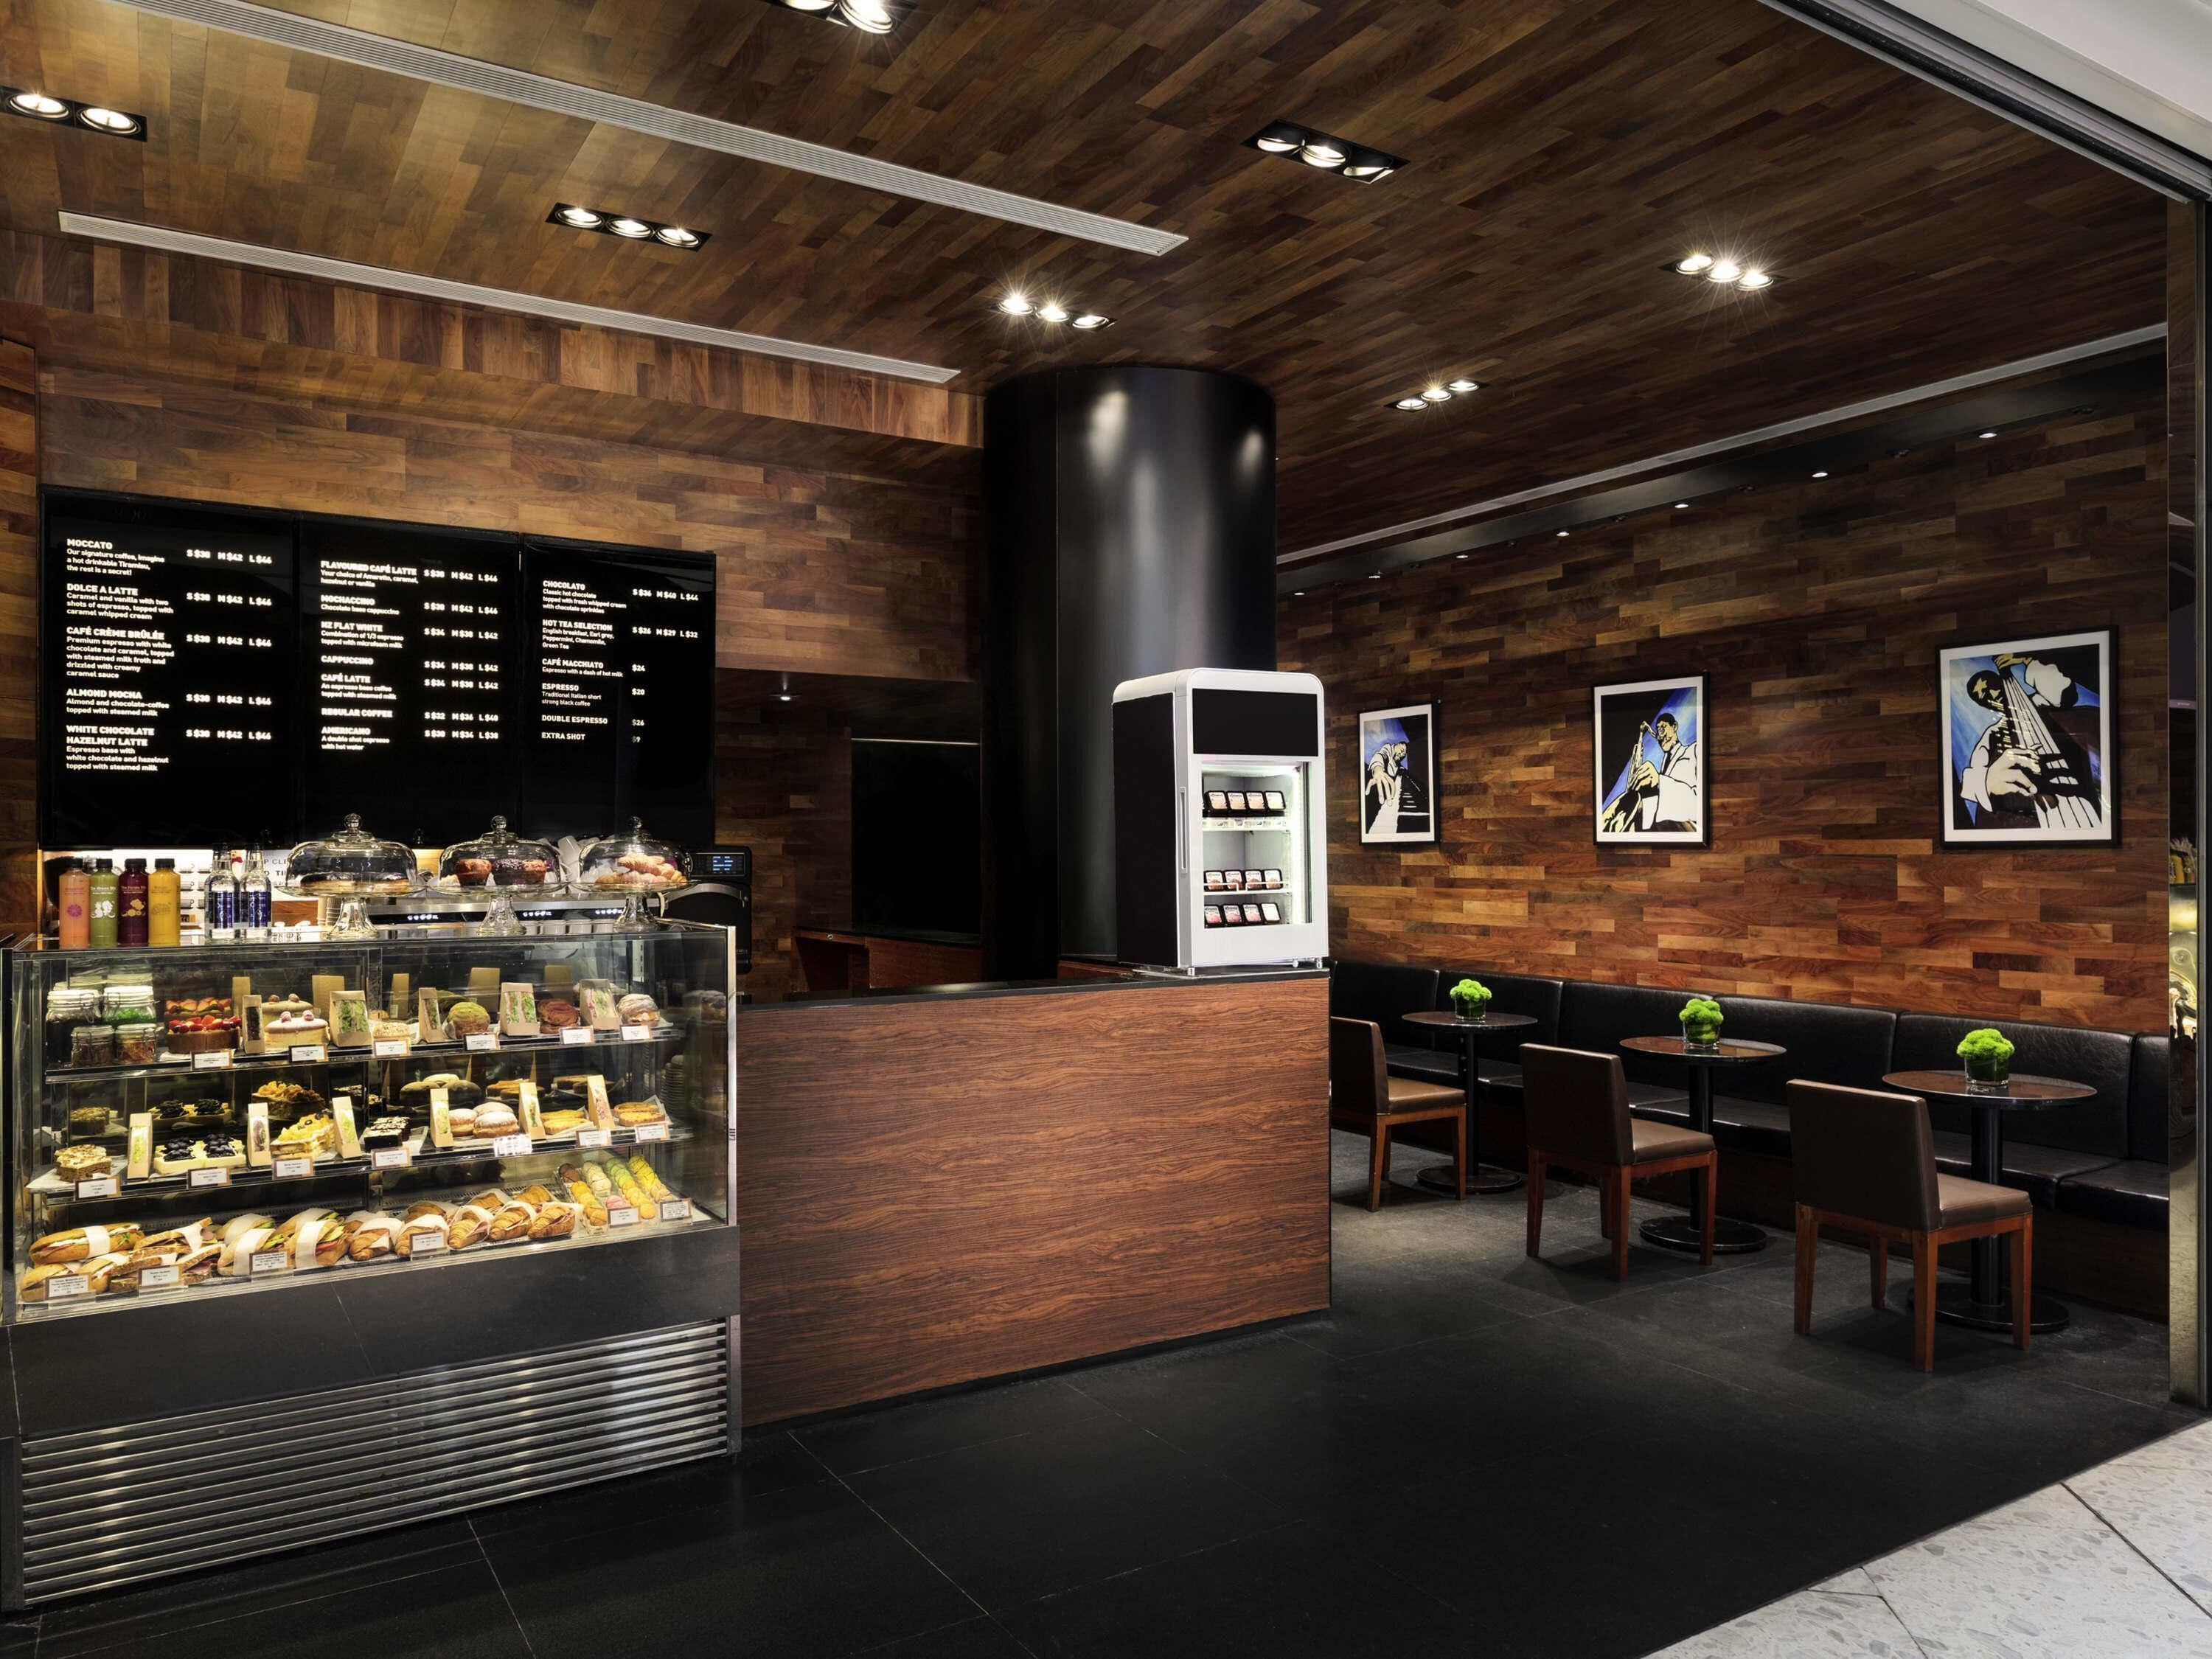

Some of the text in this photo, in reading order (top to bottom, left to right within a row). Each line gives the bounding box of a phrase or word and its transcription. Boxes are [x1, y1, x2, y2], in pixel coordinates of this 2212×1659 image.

[67, 539, 113, 549] MOCCATO
[543, 581, 585, 590] CHOCOLATO
[67, 584, 98, 592] DOLCE
[108, 587, 138, 596] LATTE
[574, 622, 613, 630] SELECTION
[563, 660, 604, 668] MACCHIATO
[66, 689, 142, 699] ALMOND MOCHA
[99, 727, 155, 735] CHOCOLATE
[66, 737, 116, 745] HAZELNUT
